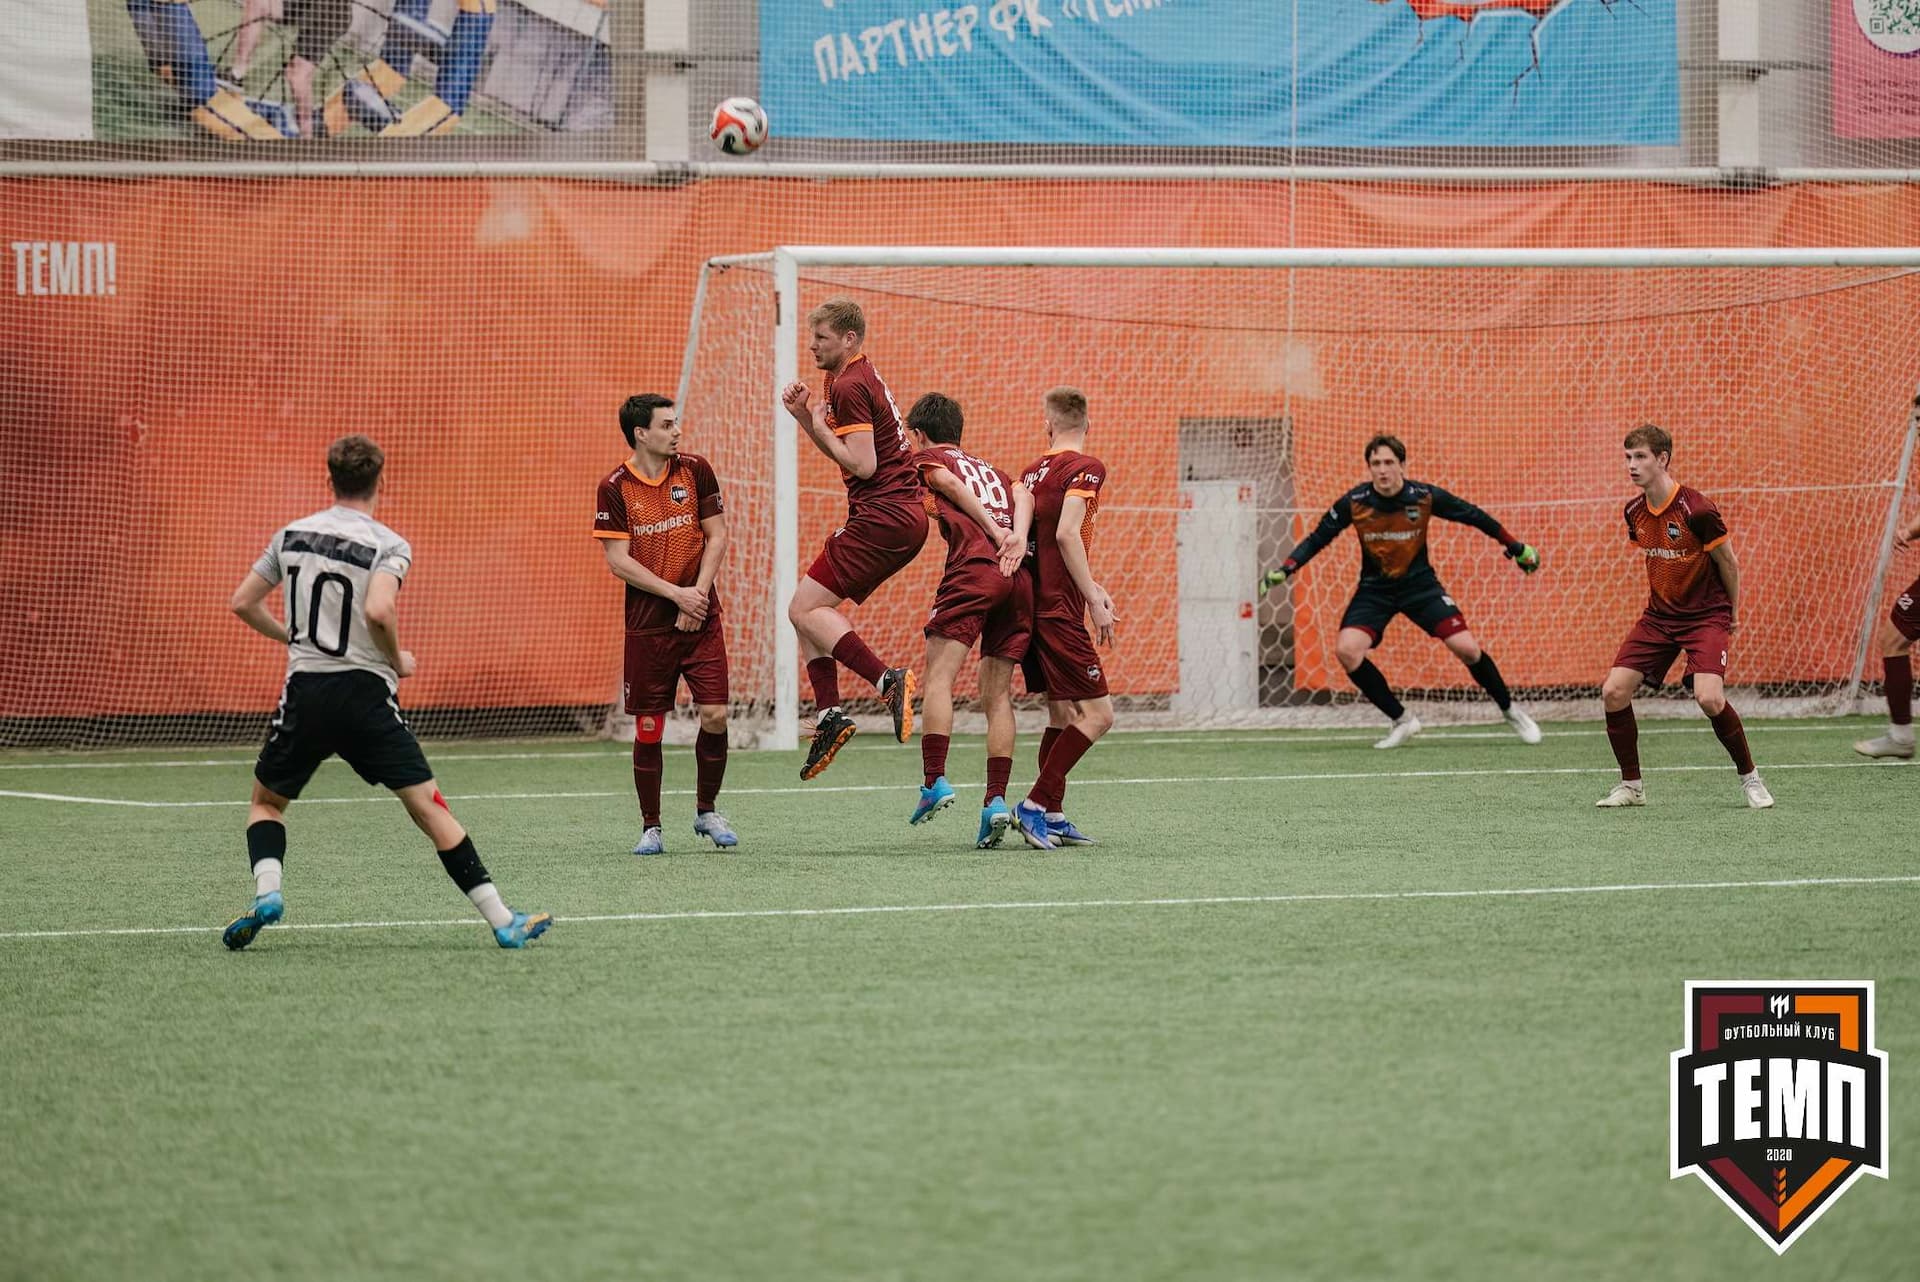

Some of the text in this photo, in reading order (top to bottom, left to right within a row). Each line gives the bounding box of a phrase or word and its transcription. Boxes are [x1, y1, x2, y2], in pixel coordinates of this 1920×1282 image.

[814, 0, 1052, 85] ПАРТНЕР ФК
[11, 241, 116, 296] ТЕМП!
[957, 459, 1008, 509] 88
[287, 566, 353, 657] 10
